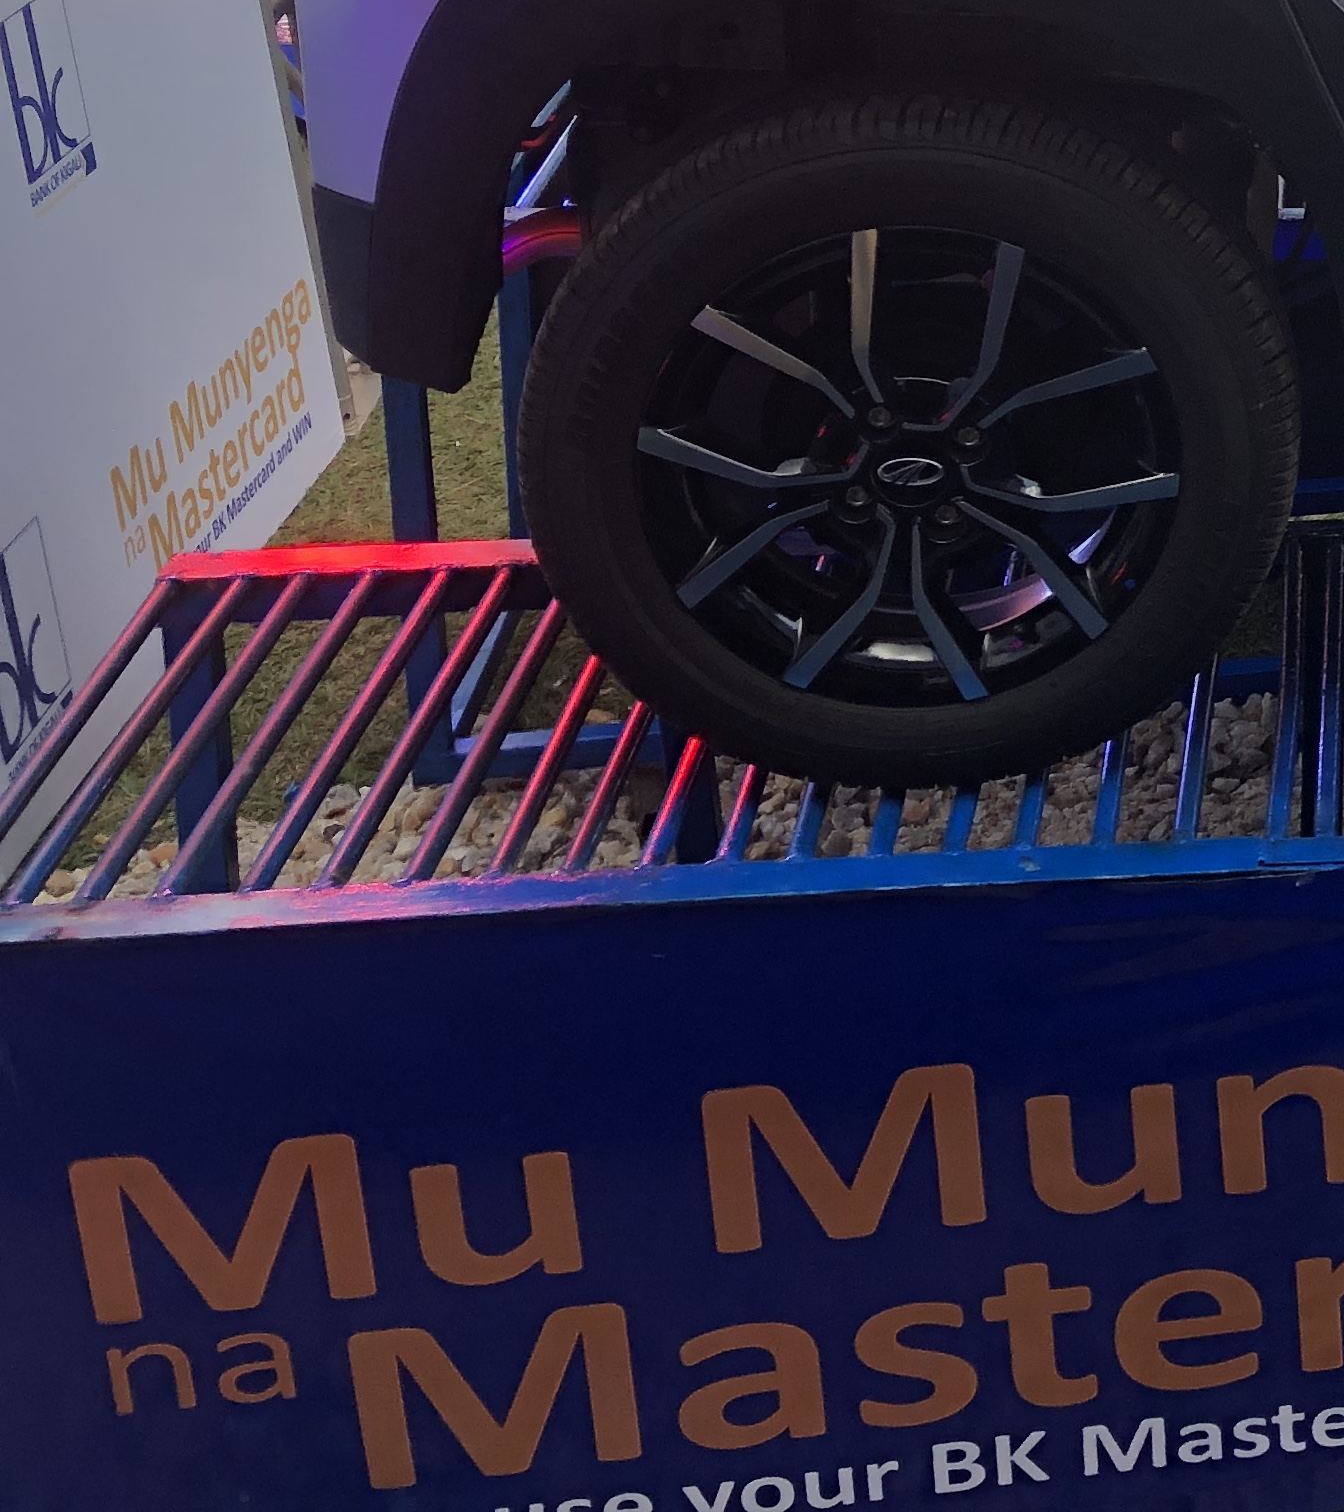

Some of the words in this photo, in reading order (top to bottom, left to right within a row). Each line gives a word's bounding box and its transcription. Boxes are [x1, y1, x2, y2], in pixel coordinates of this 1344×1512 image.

[110, 437, 168, 532] Mu
[169, 278, 312, 464] Munyenga
[148, 355, 305, 573] Mastercard
[212, 511, 227, 541] BK
[226, 451, 276, 524] Mastercard
[276, 431, 293, 465] and
[292, 411, 312, 445] WIN
[124, 524, 147, 568] na
[68, 1133, 584, 1325] Mu
[105, 1331, 298, 1416] na
[682, 1457, 899, 1512] your
[931, 1430, 1049, 1495] BK
